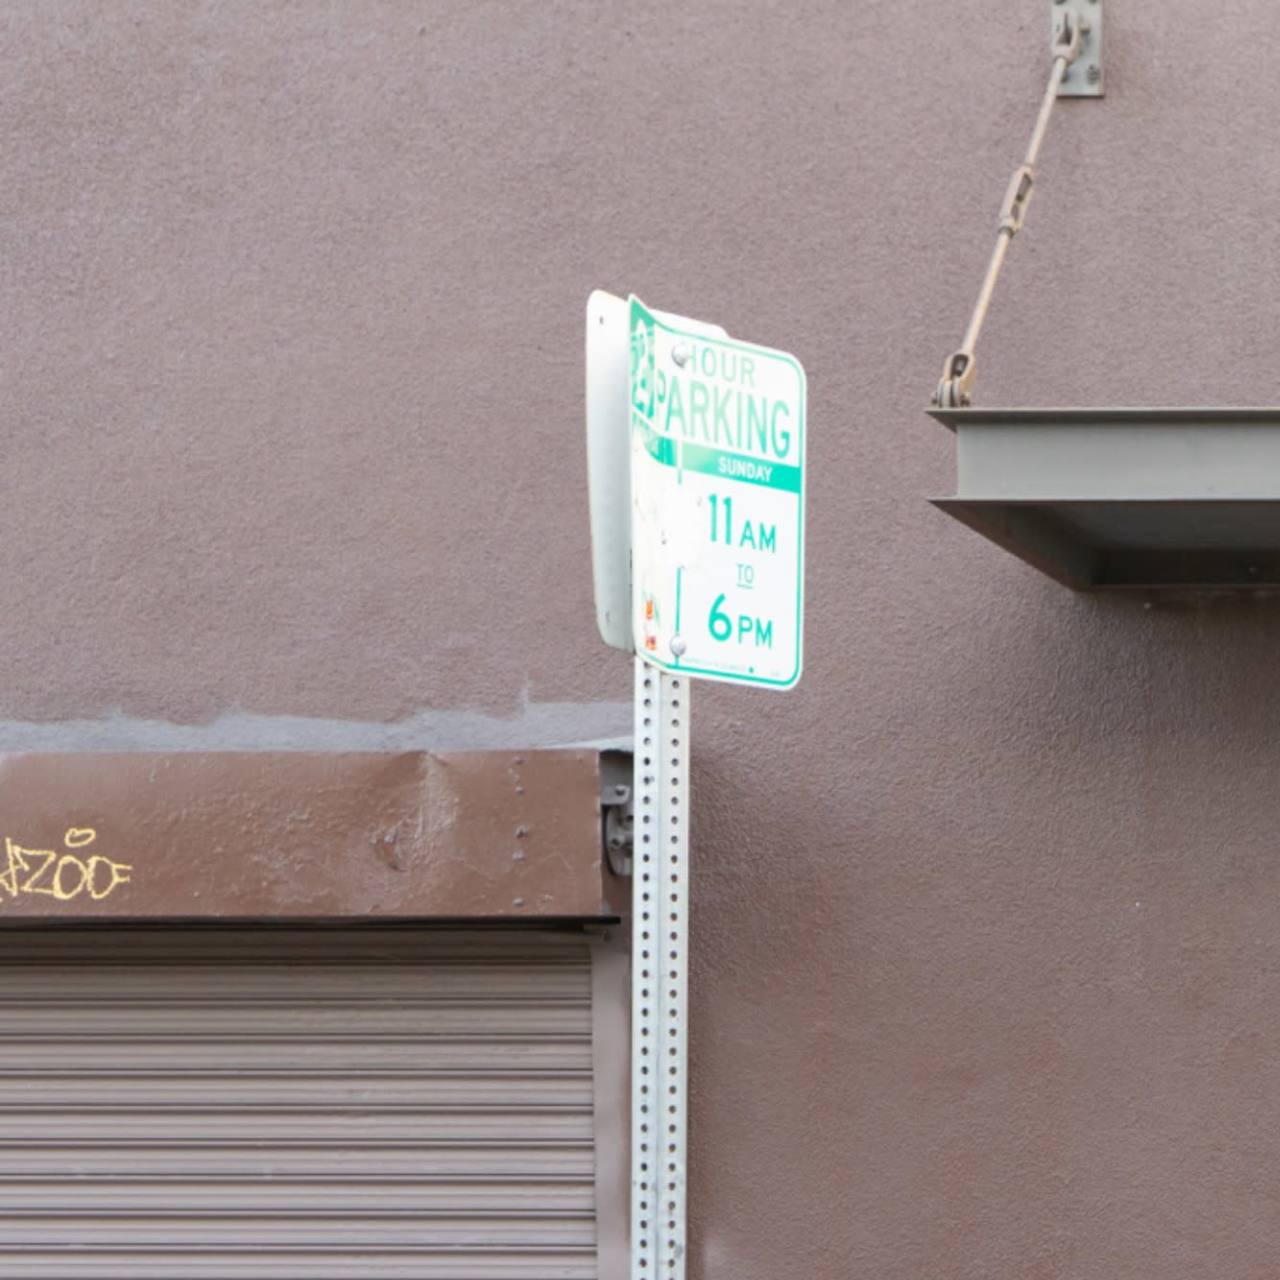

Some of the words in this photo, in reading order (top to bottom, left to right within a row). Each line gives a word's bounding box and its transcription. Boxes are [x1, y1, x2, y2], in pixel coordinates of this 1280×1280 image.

[656, 368, 791, 458] PARKING
[718, 456, 773, 483] SUNDAY
[708, 493, 733, 545] 11
[739, 520, 777, 554] AM
[736, 563, 756, 585] TO
[708, 593, 732, 642] 6
[737, 615, 774, 649] PM
